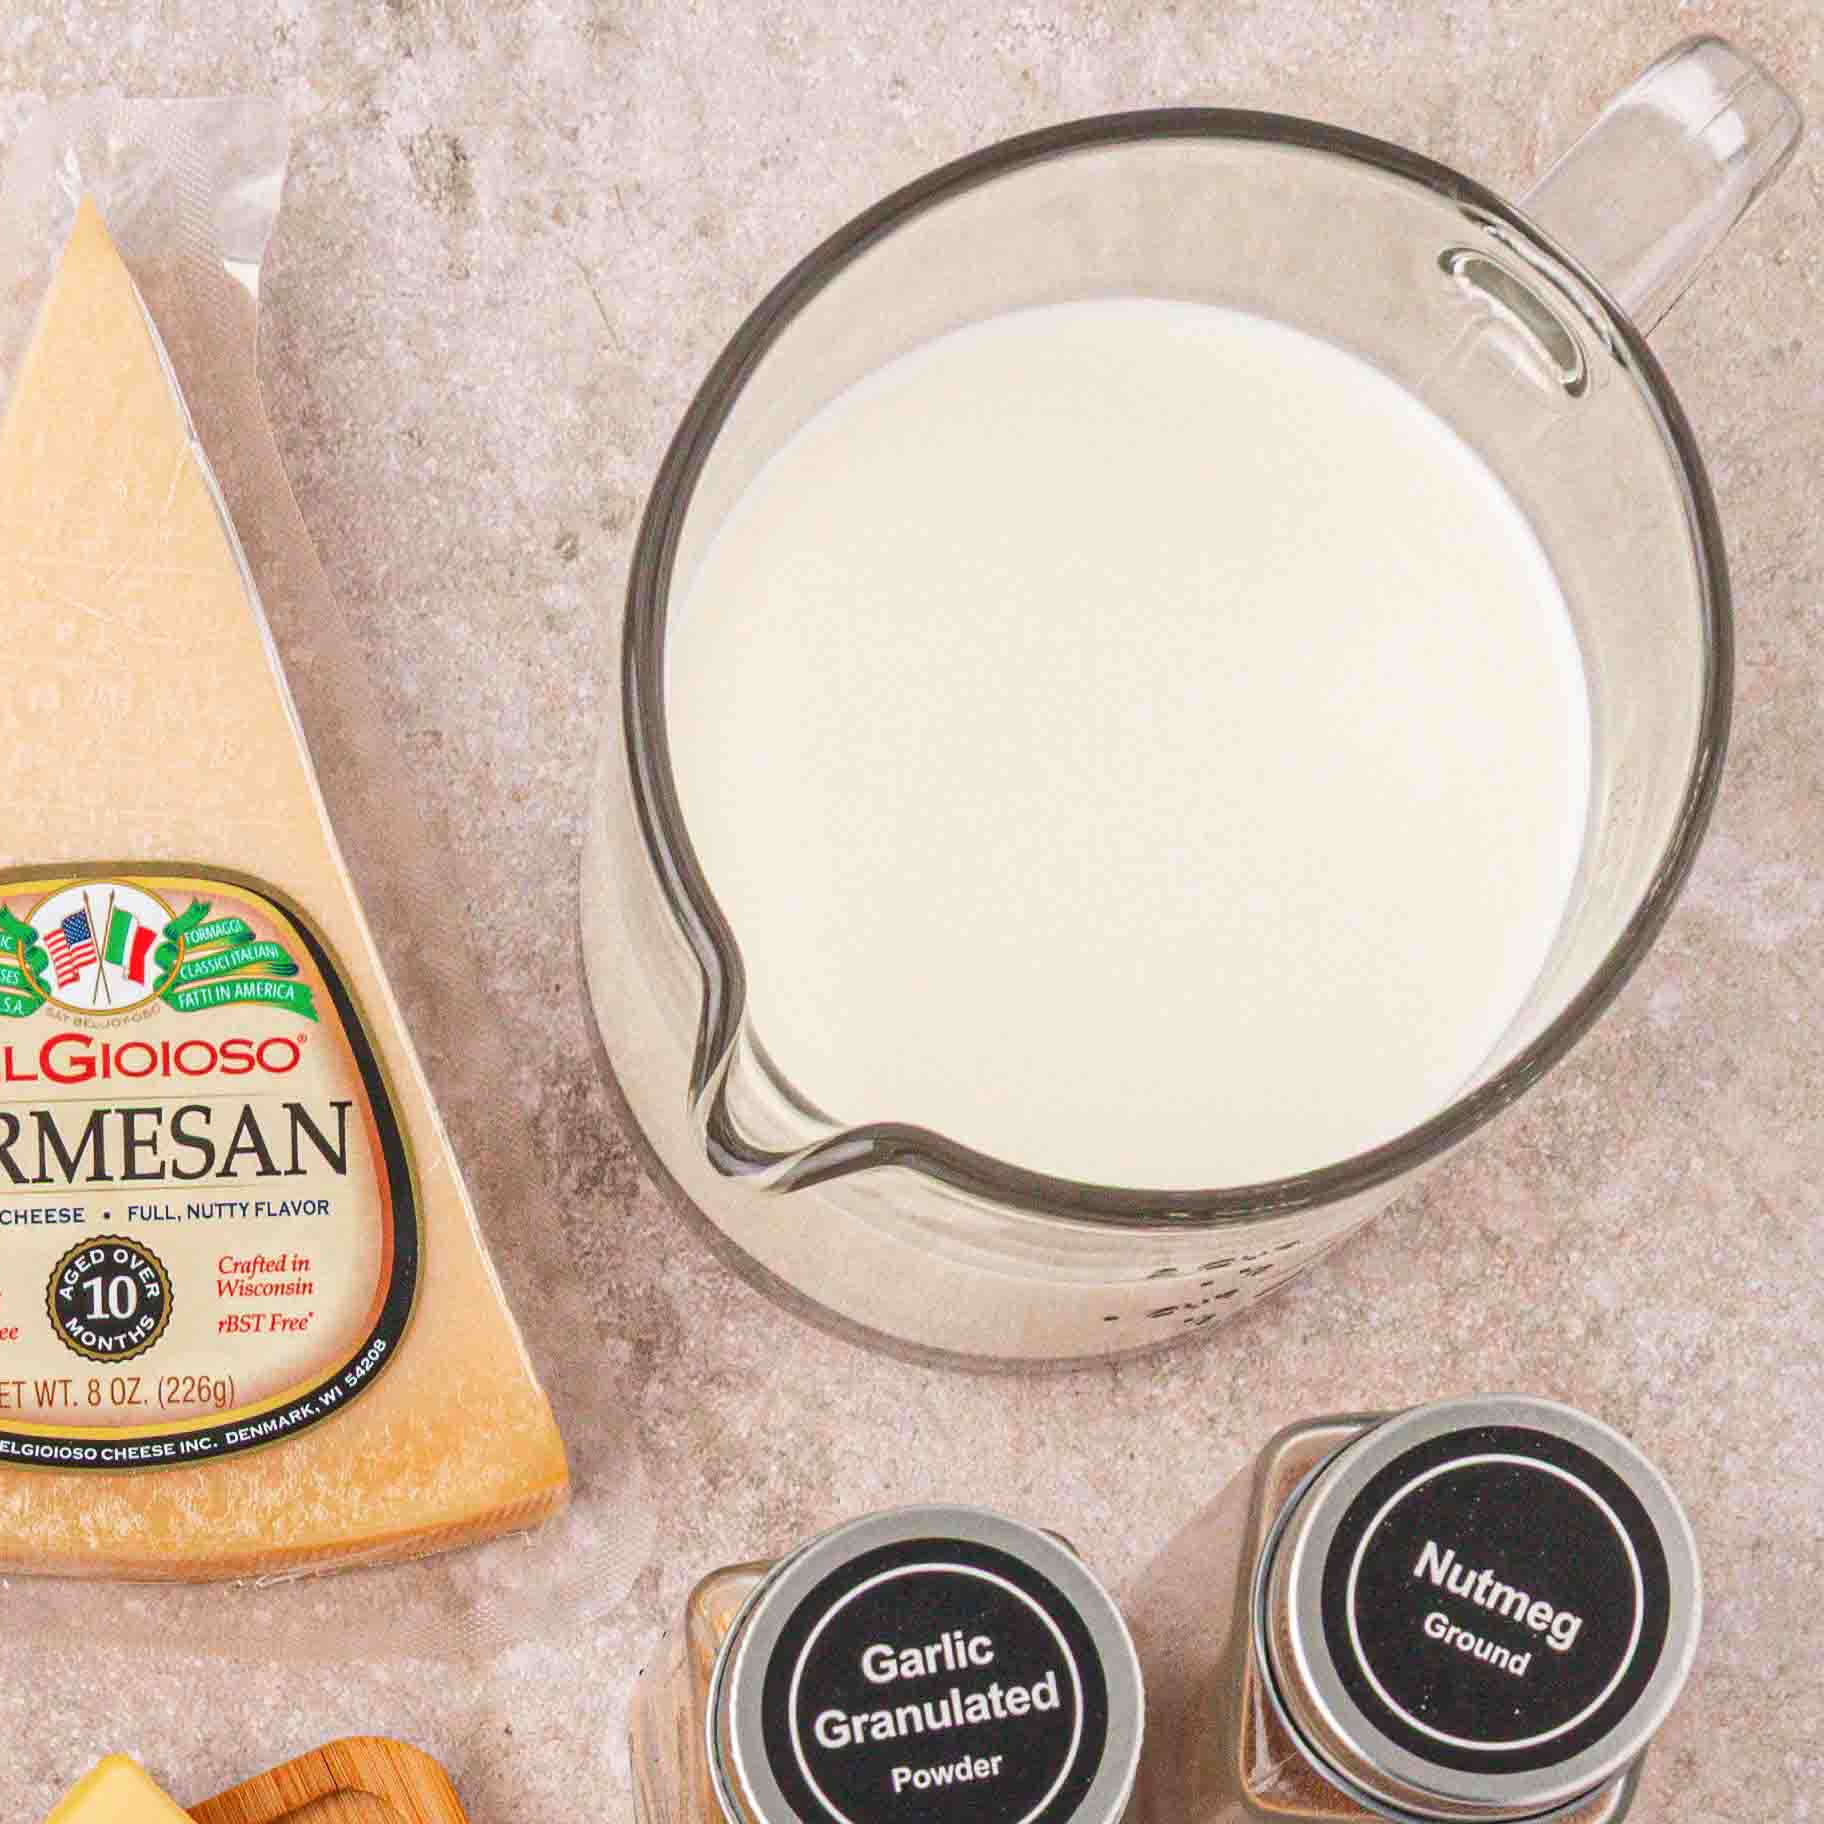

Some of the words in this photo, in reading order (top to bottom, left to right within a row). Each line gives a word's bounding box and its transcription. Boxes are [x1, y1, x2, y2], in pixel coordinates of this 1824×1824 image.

[177, 987, 214, 1009] FATTI
[233, 983, 295, 1001] AMERICA
[0, 1207, 85, 1226] CHEESE
[127, 1205, 183, 1223] FULL,
[186, 1202, 249, 1221] NUTTY
[254, 1200, 331, 1218] FLAVOR
[58, 1248, 106, 1302] AGED
[112, 1248, 161, 1299] OVER
[215, 1278, 315, 1299] Wisconsin
[217, 1256, 288, 1281] Crafted
[81, 1274, 138, 1321] 10
[64, 1313, 156, 1353] MONTHS
[216, 1314, 267, 1334] rBST
[33, 1379, 78, 1408] WT.
[158, 1375, 237, 1409] (226g)
[100, 1444, 177, 1461] CHEESE
[345, 1338, 387, 1387] 54208
[1413, 1540, 1583, 1652] Nutmeg
[860, 1629, 995, 1684] Garlic
[1422, 1611, 1533, 1678] Ground
[813, 1670, 1061, 1750] Granulated
[890, 1753, 1003, 1793] Powder
